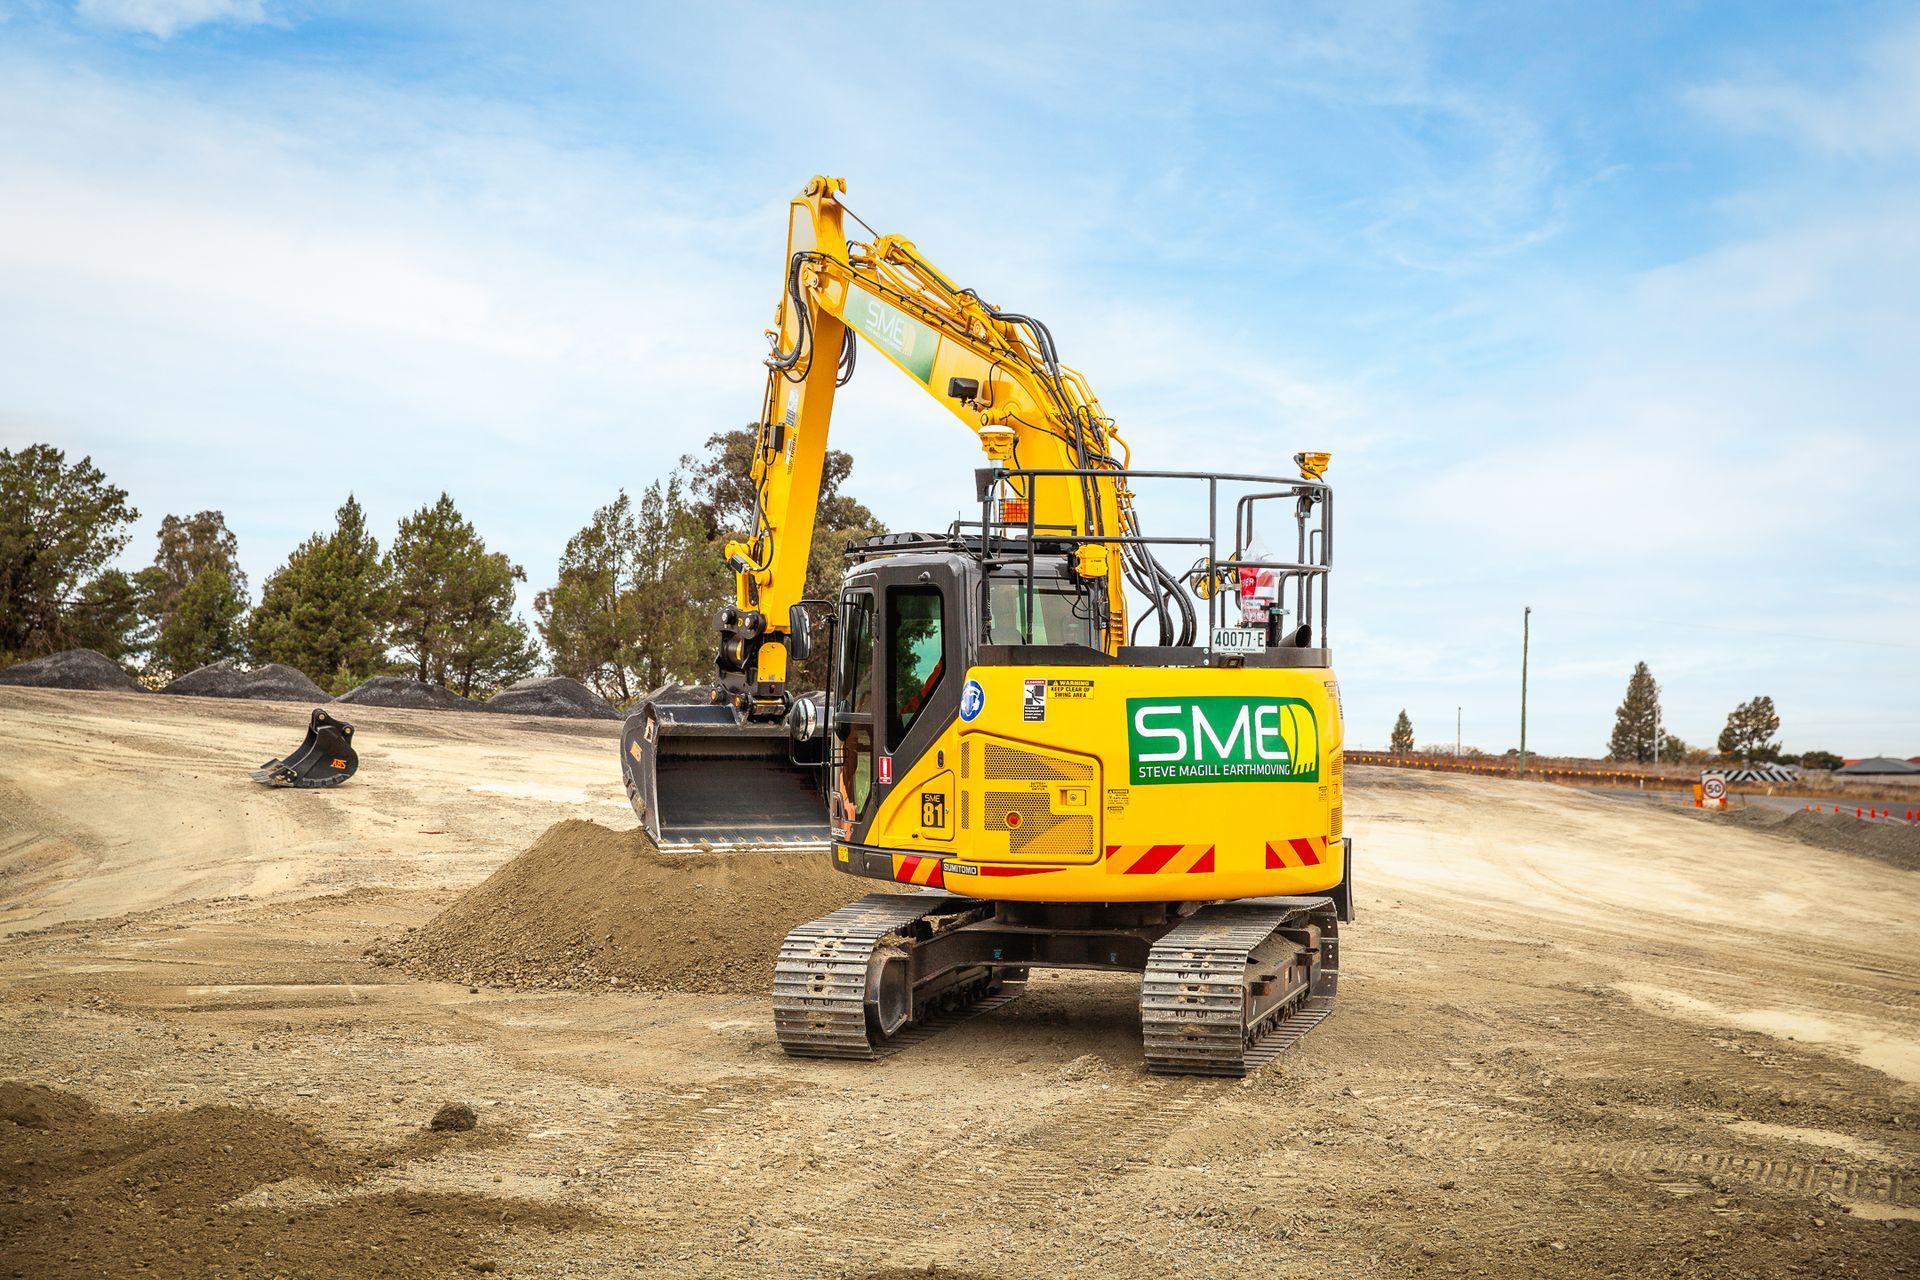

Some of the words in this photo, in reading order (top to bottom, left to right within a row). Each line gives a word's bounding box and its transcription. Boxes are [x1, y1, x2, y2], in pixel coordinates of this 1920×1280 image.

[865, 300, 905, 346] SME
[1134, 704, 1289, 762] SME
[1138, 765, 1176, 778] STEVE
[1179, 764, 1220, 776] MAGILL
[1223, 764, 1290, 776] EARTHMOVING
[1707, 784, 1721, 794] 50
[924, 794, 941, 803] SME
[923, 802, 943, 827] 81
[943, 862, 977, 875] SUMITOMO
